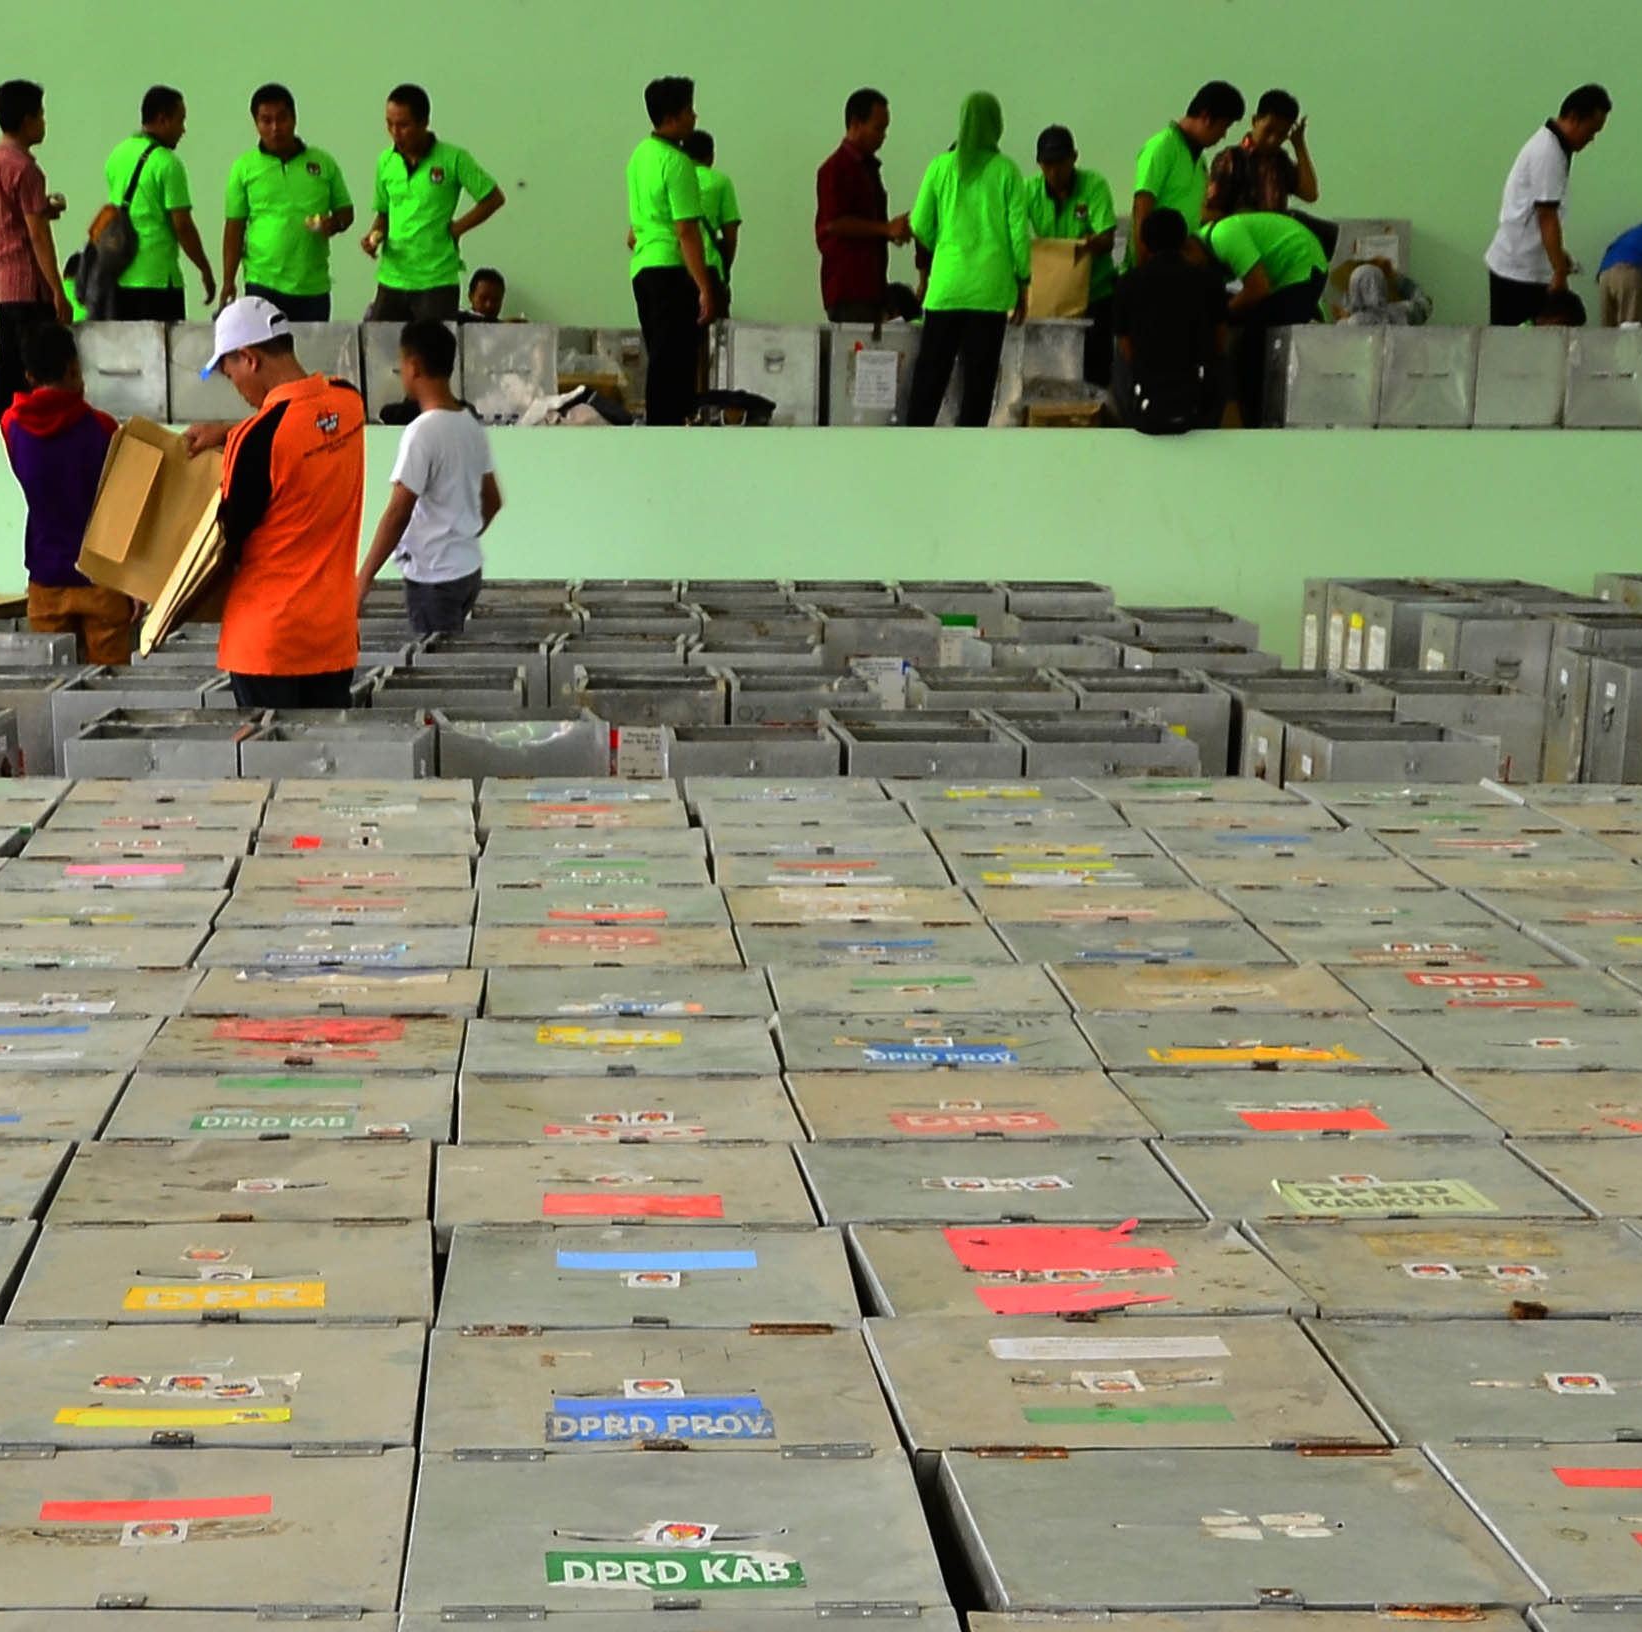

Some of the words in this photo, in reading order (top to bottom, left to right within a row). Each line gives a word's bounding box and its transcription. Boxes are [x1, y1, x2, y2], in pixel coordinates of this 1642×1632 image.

[1418, 974, 1530, 988] DPD
[944, 1050, 1015, 1063] PROV
[200, 1115, 283, 1130] DPRD
[290, 1115, 346, 1130] KAB
[907, 1113, 1047, 1128] DPD
[1295, 1182, 1451, 1198] DPRD
[142, 1286, 303, 1306] DPR
[552, 1413, 656, 1437] DPRD
[561, 1557, 689, 1585] DPRD
[699, 1557, 791, 1584] KAB
